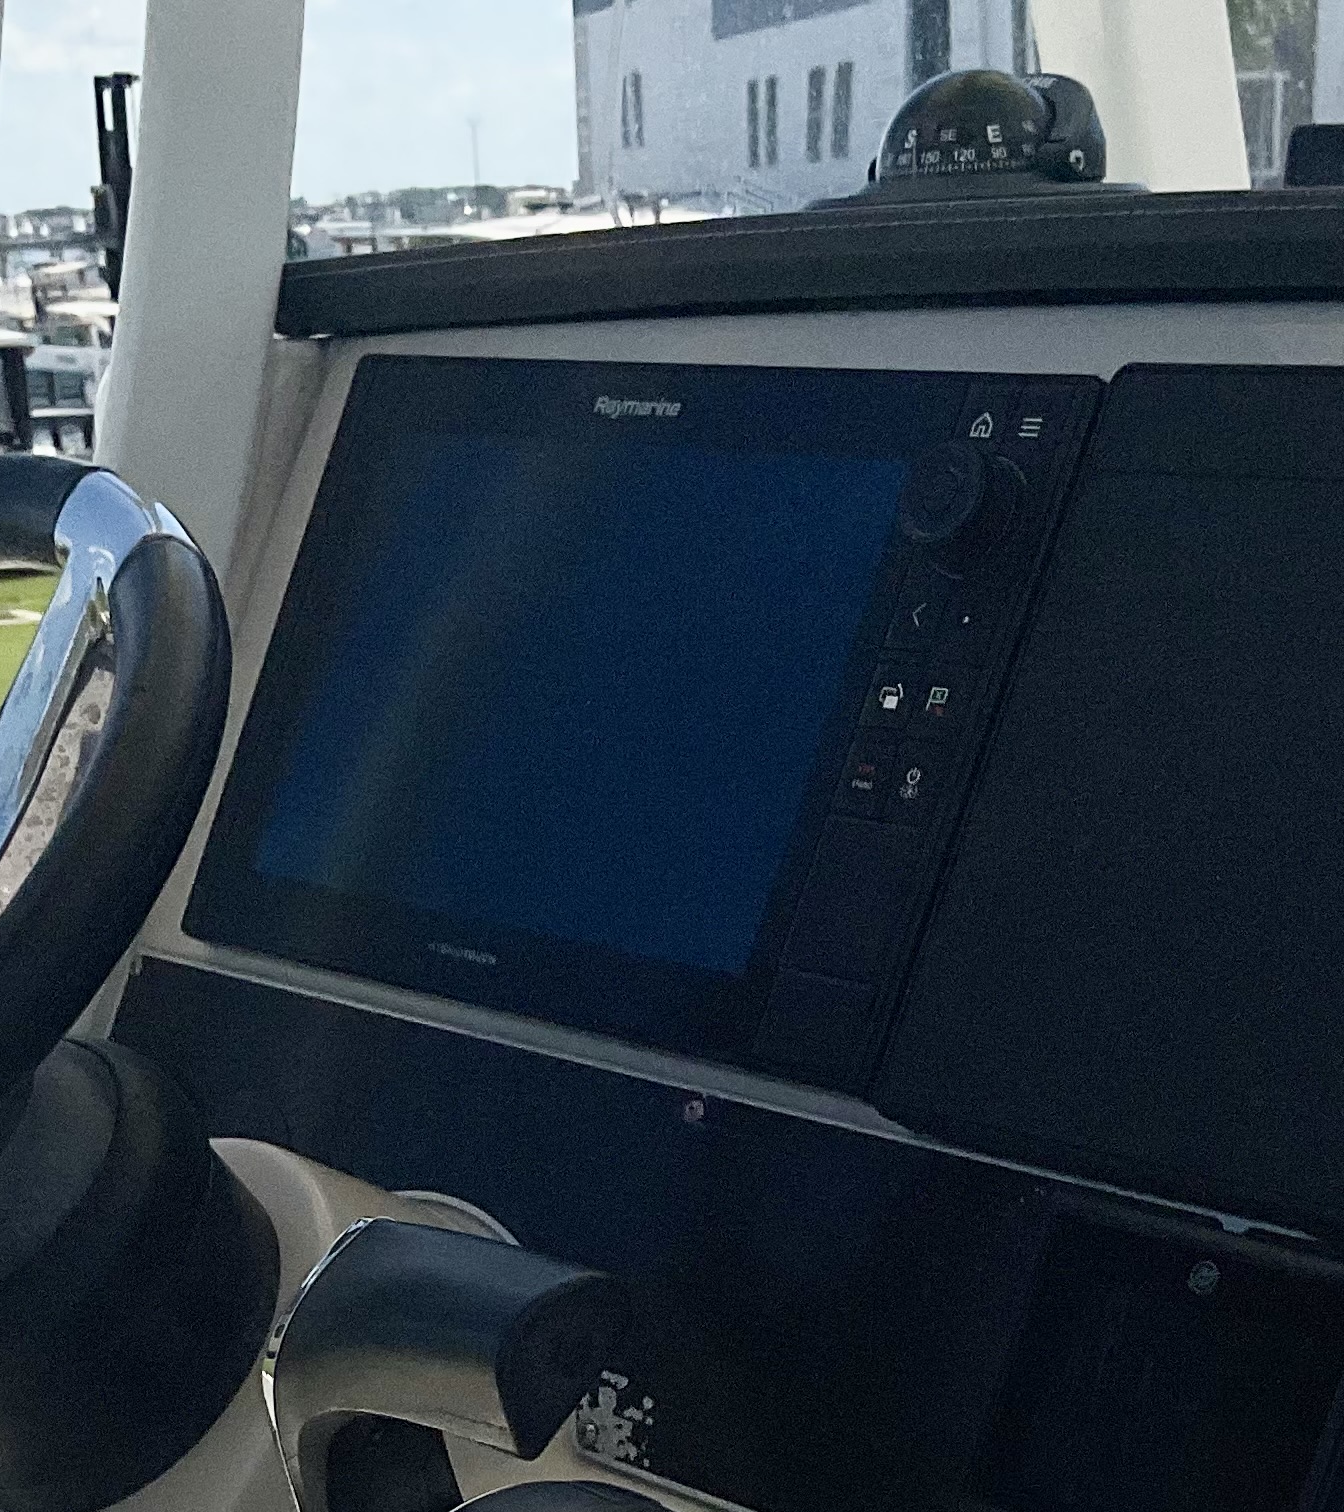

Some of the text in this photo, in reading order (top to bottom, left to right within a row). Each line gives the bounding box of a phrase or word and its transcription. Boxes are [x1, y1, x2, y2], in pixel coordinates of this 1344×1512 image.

[986, 124, 1003, 143] E
[954, 147, 976, 162] 120
[592, 394, 682, 420] Raymarine
